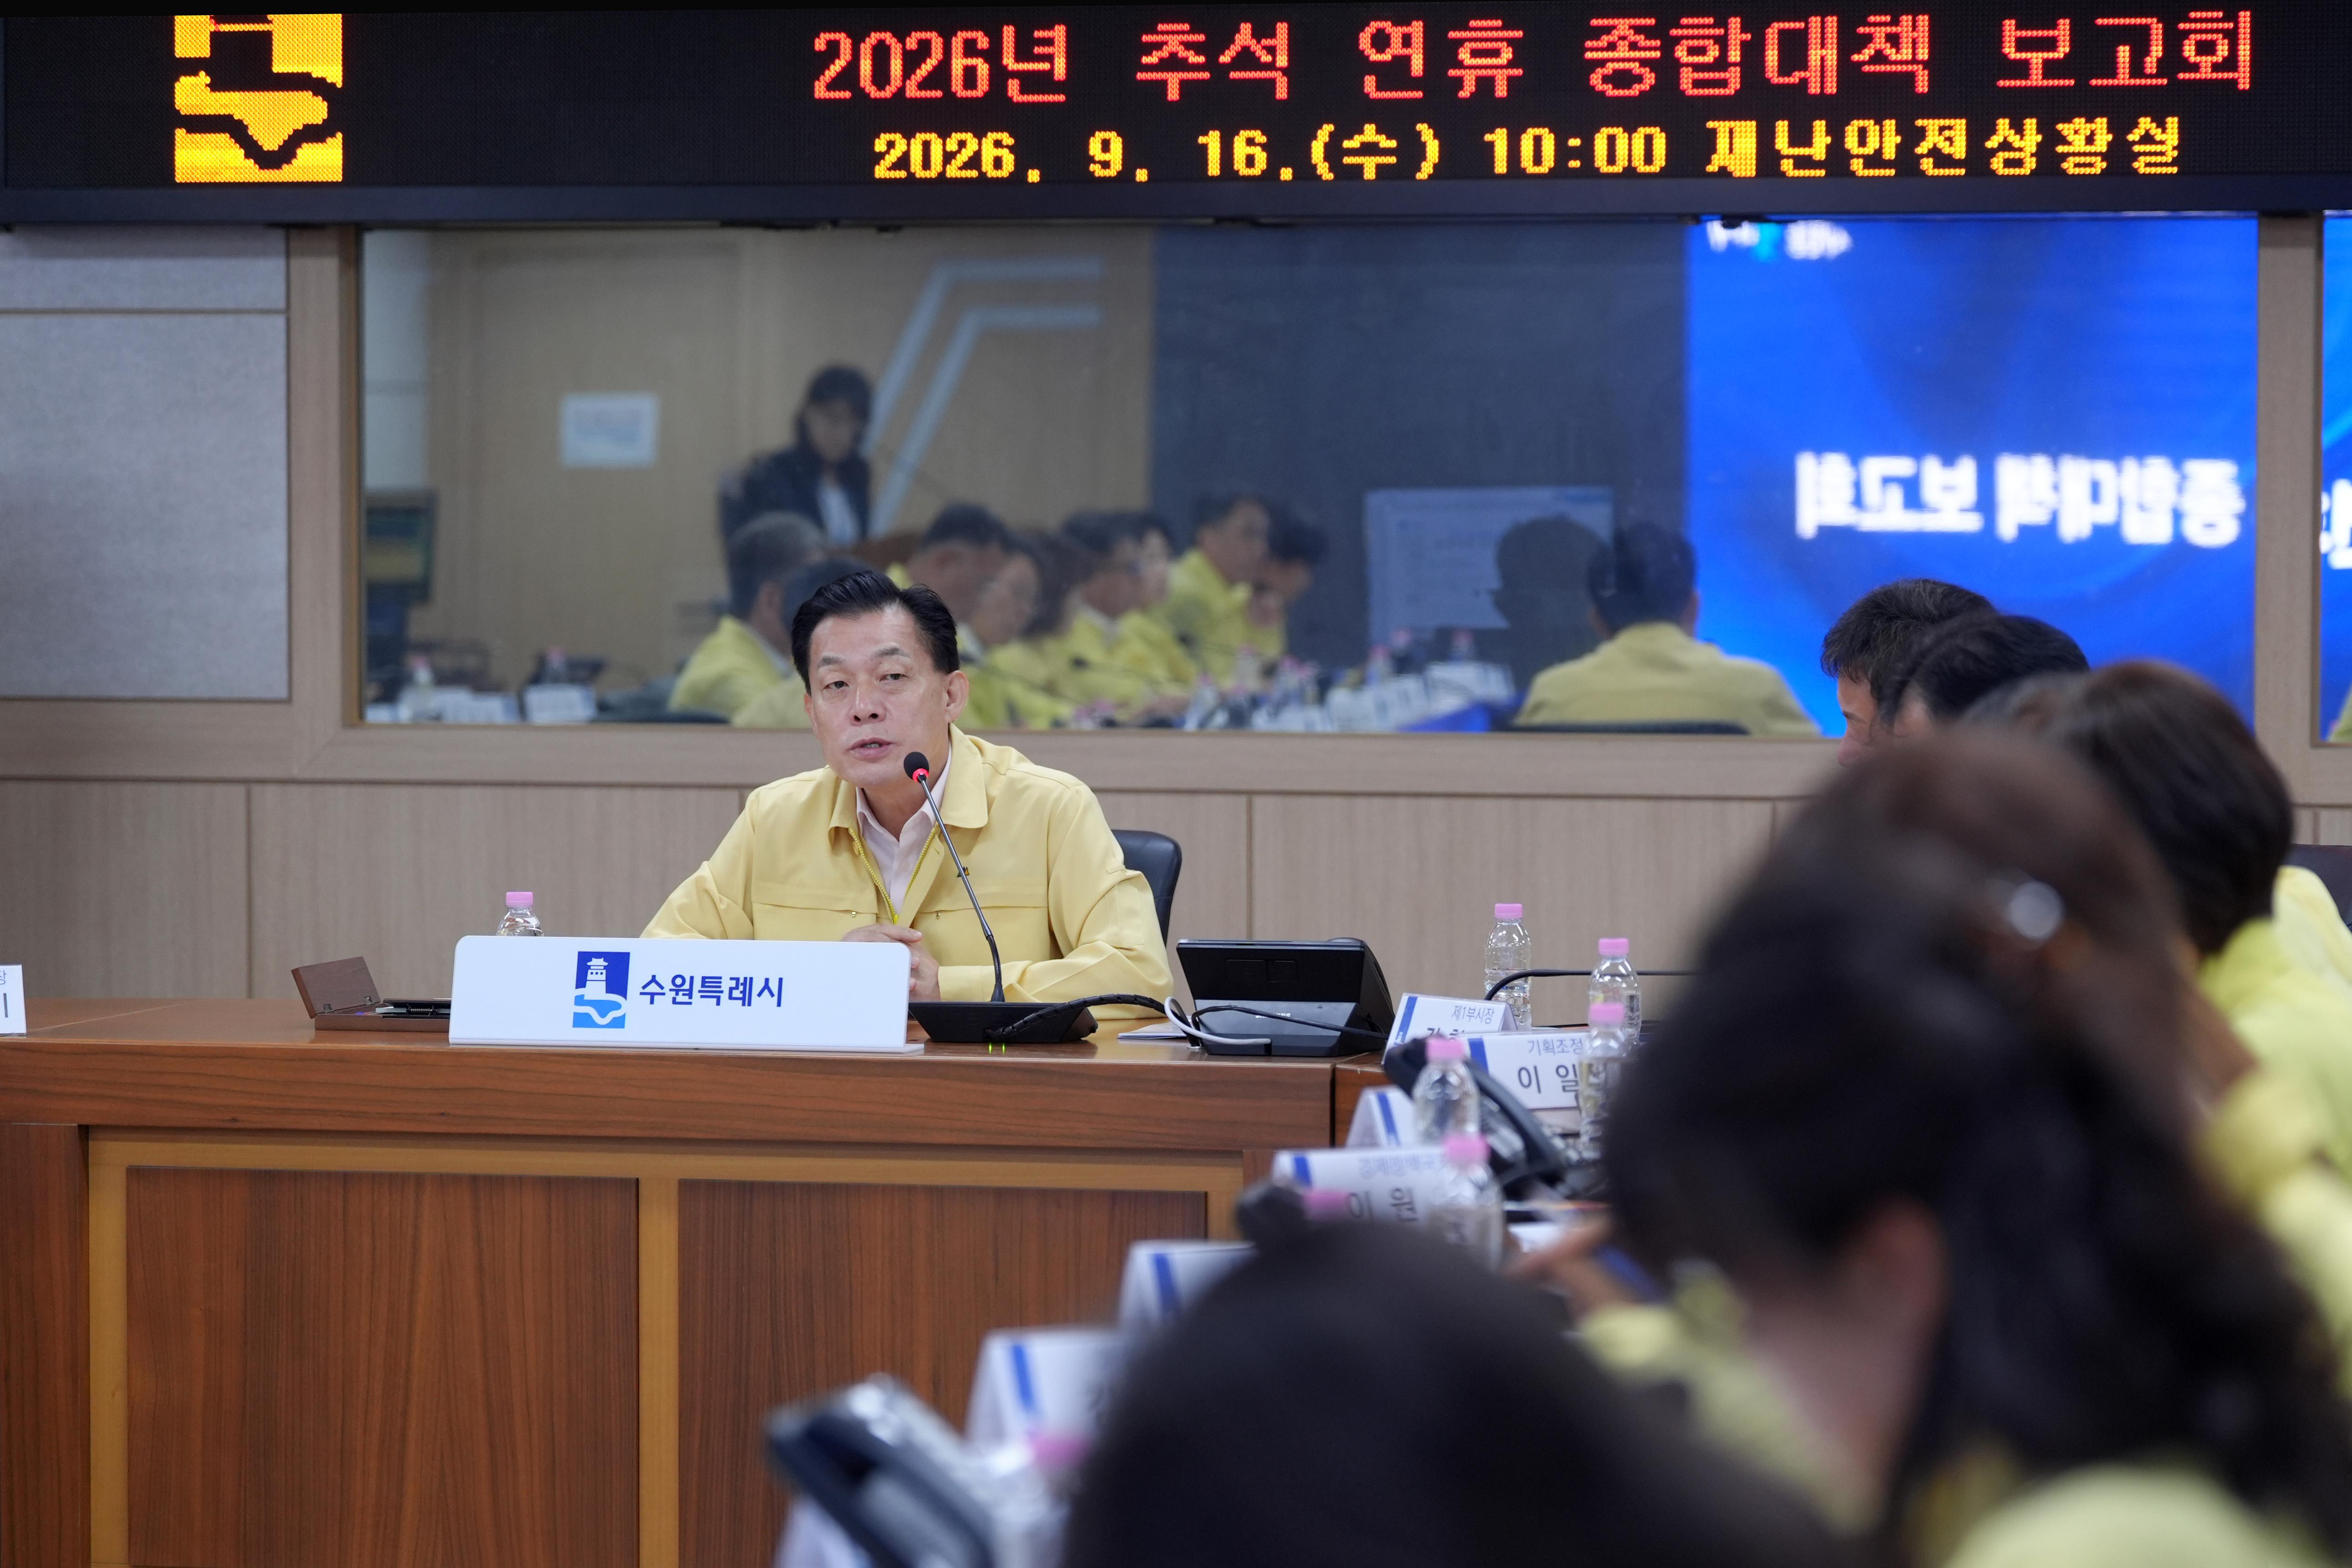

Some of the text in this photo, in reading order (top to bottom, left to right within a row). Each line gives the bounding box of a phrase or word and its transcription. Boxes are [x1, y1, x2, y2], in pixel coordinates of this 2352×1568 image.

[814, 10, 2251, 103] 2026년 추석 연휴 종합대책 보고회
[874, 132, 1040, 183] 2026.
[1089, 131, 1148, 182] 9.
[1483, 126, 1666, 174] 10:00
[1706, 116, 2179, 177] 재난안전상황실
[639, 974, 783, 1007] 수원특례시
[1451, 1005, 1495, 1025] 제1부시장
[1528, 1038, 1584, 1056] 기획조정
[1518, 1065, 1542, 1094] 이
